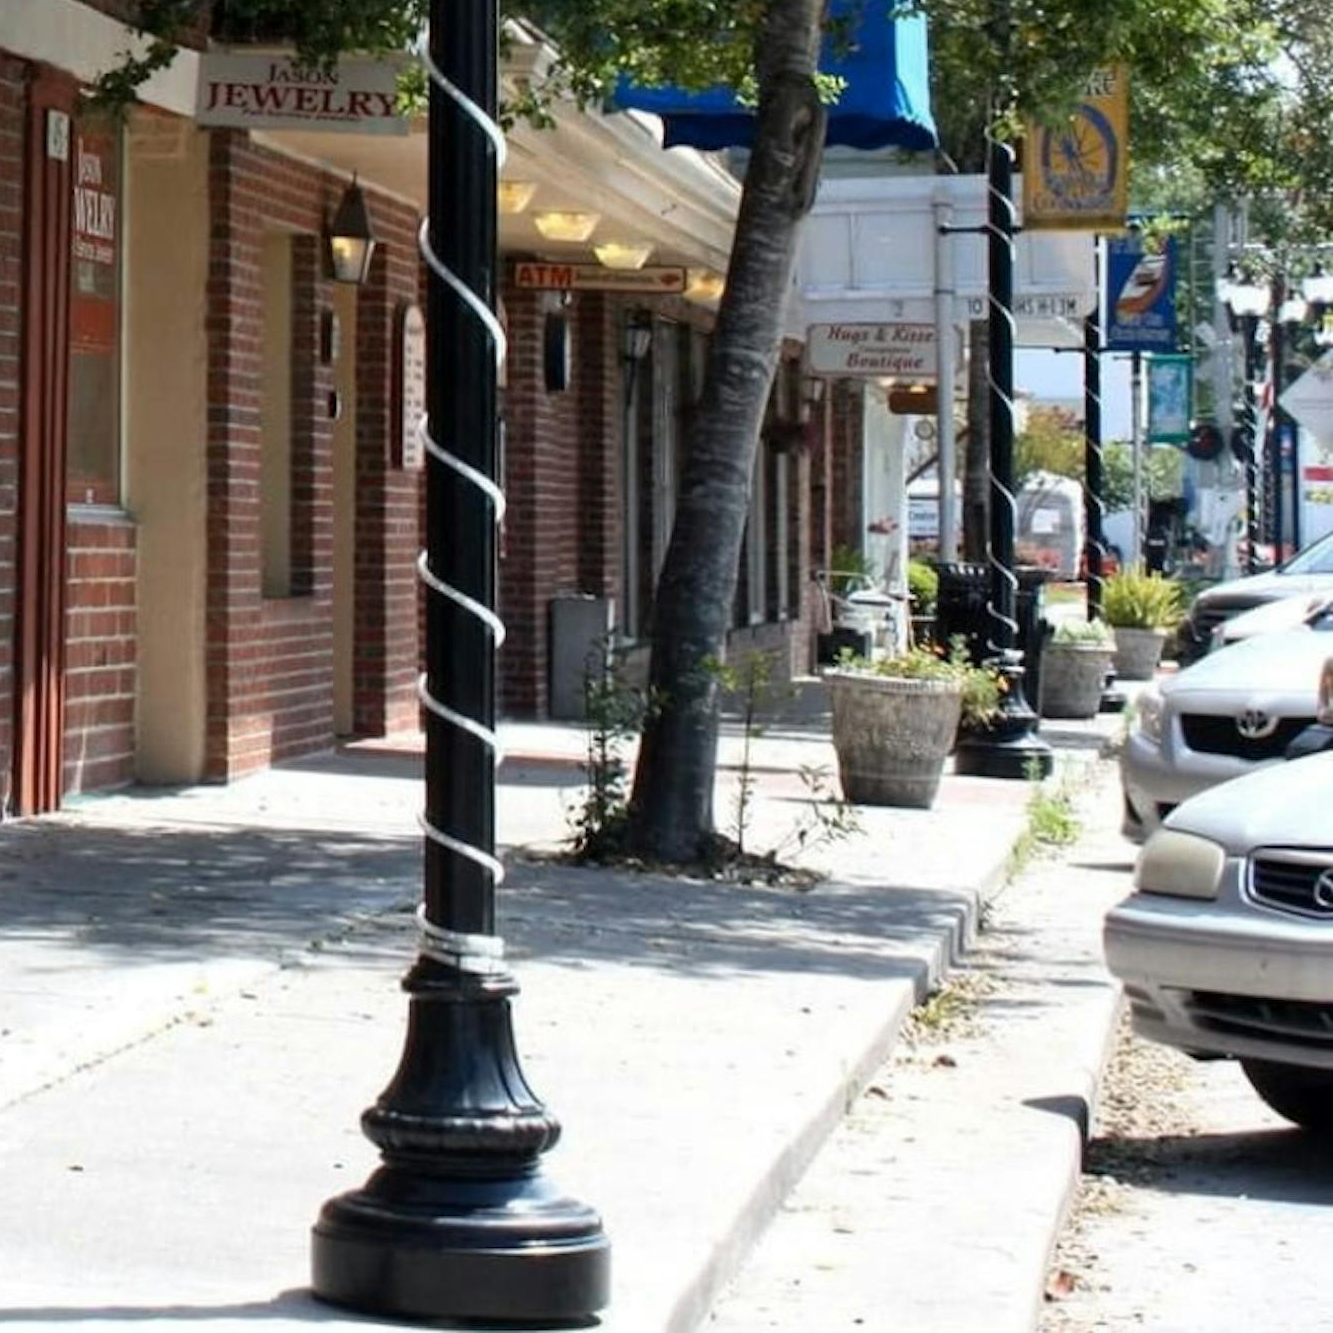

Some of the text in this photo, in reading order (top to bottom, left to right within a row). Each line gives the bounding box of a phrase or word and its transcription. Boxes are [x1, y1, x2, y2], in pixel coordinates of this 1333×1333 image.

[207, 82, 403, 117] JEWELRY
[519, 267, 573, 288] ATM
[892, 326, 934, 343] Kisse
[847, 353, 924, 371] Boutique
